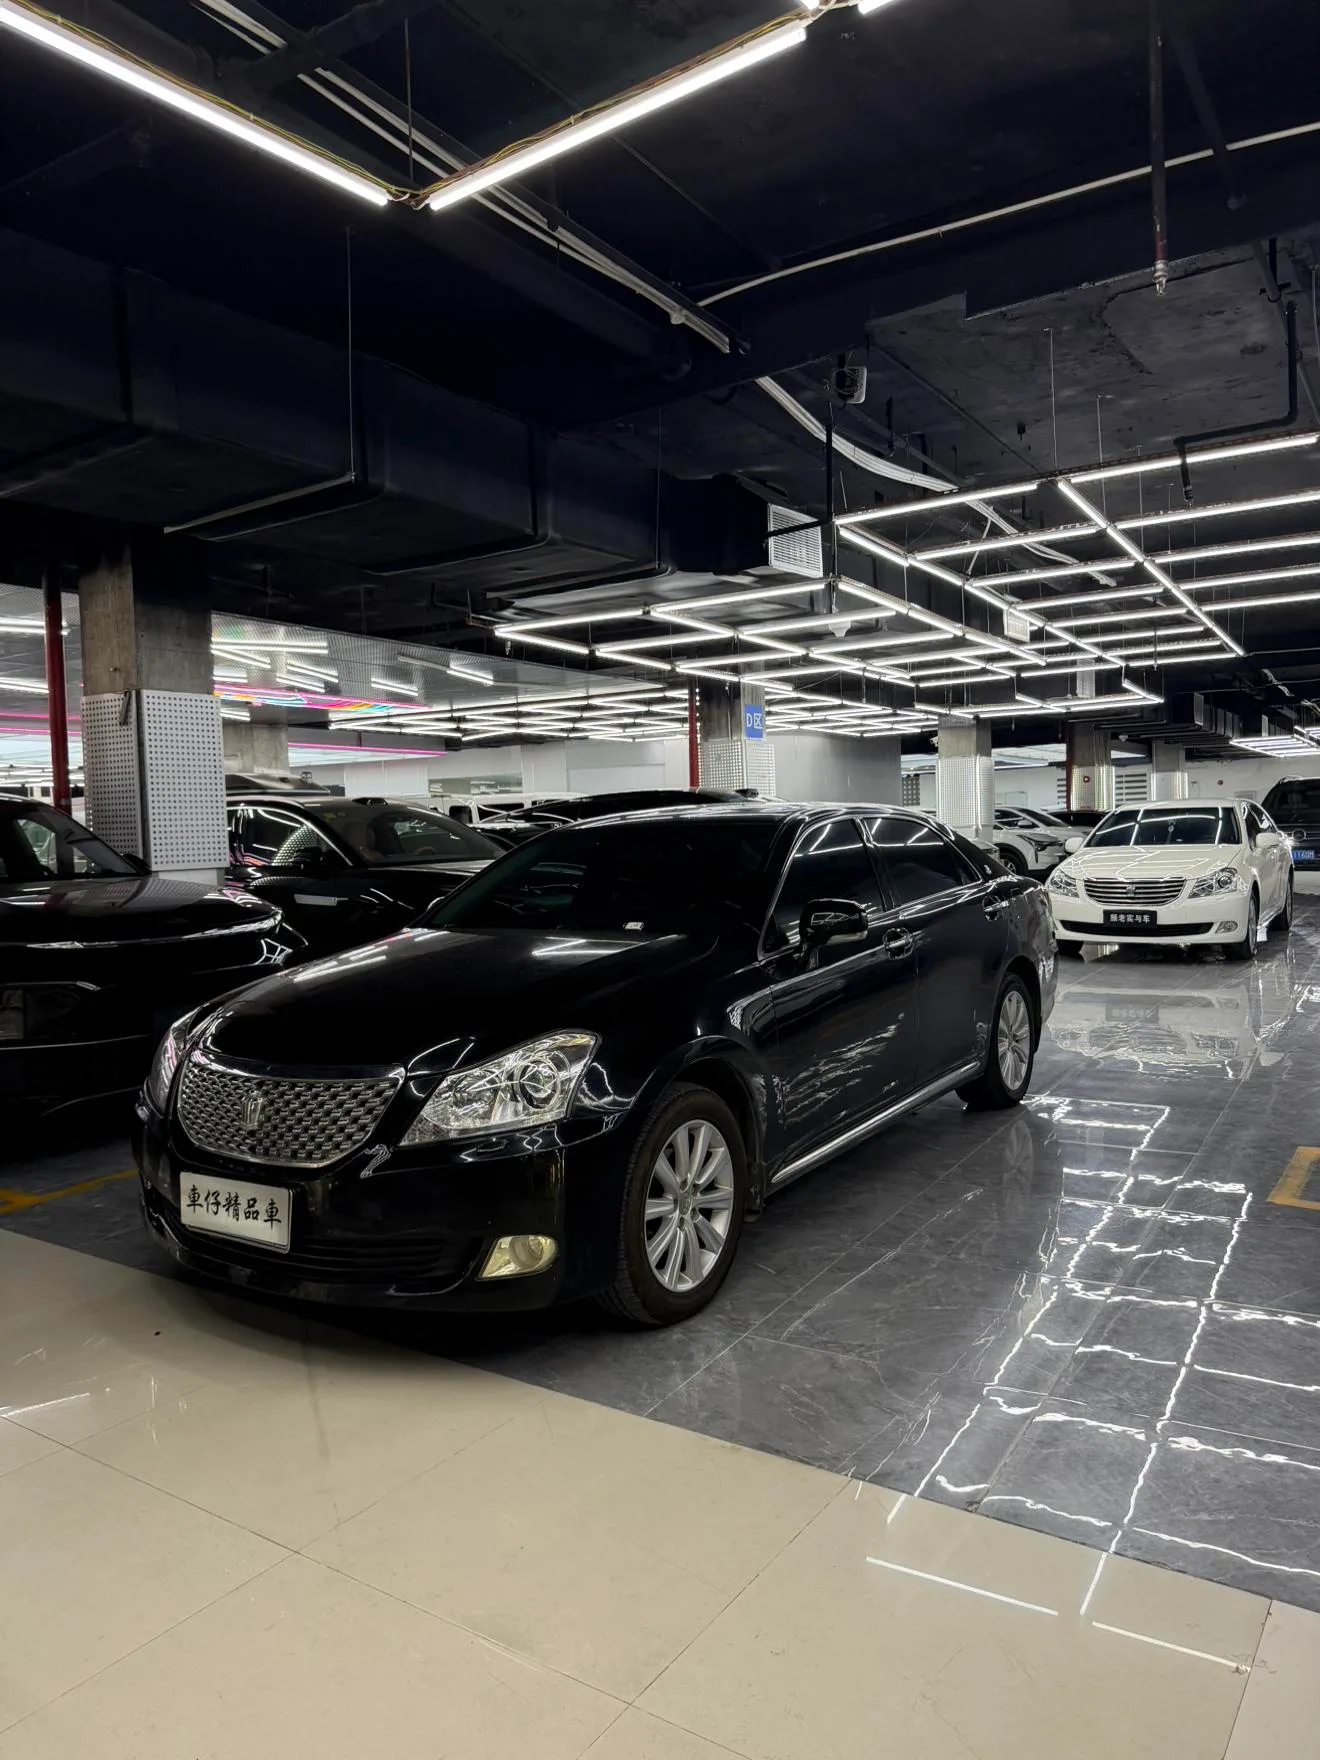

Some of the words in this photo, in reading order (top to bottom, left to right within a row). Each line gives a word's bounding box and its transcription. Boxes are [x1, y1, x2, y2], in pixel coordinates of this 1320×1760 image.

[746, 712, 763, 730] D区
[186, 1184, 282, 1230] 車仔精品車
